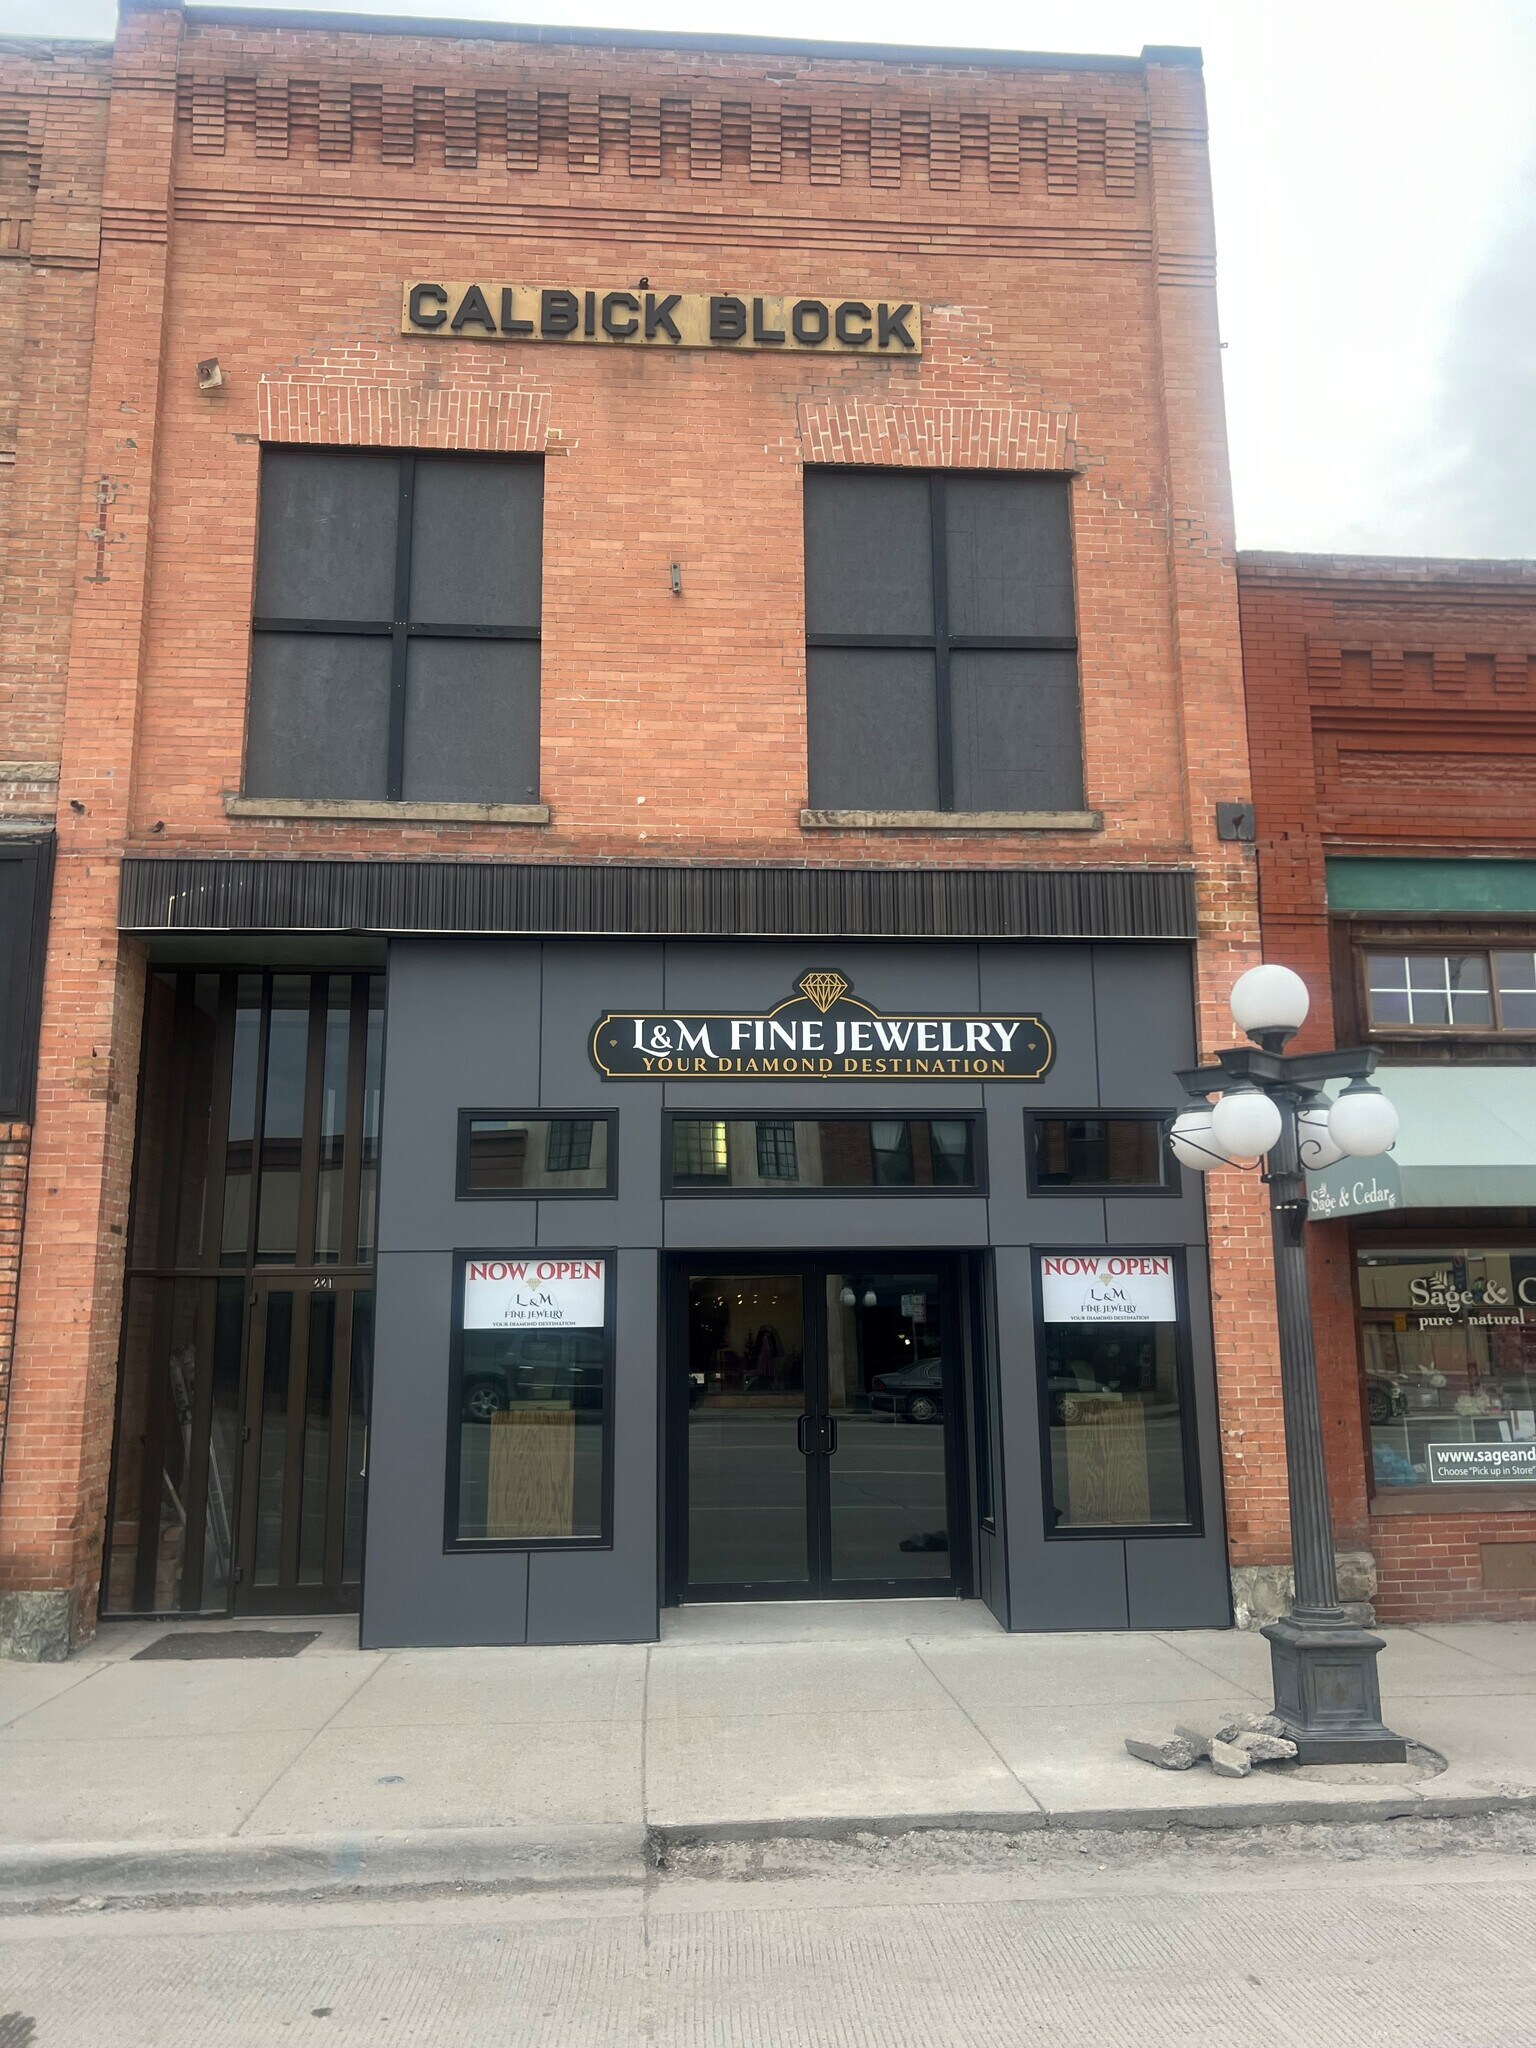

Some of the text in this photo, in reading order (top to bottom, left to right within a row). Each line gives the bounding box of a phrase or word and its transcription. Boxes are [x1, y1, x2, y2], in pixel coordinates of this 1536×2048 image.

[408, 283, 916, 348] CALBICK BLOCK
[633, 1019, 1020, 1058] L&M FINE JEWELRY
[642, 1057, 1005, 1073] YOUR DIAMOND DESTINATION
[1310, 1177, 1389, 1216] Sage & Cedar
[469, 1261, 602, 1280] NOW OPEN
[1044, 1258, 1169, 1275] NOW OPEN
[1410, 1278, 1476, 1313] Sage
[1483, 1280, 1508, 1304] &
[504, 1309, 564, 1319] FINE JEWELRY
[1081, 1303, 1137, 1313] FINE JEWELRY
[1419, 1316, 1454, 1331] pure
[1468, 1308, 1525, 1325] natural
[1438, 1466, 1468, 1476] Choose
[1491, 1467, 1501, 1477] up
[1503, 1466, 1511, 1475] in
